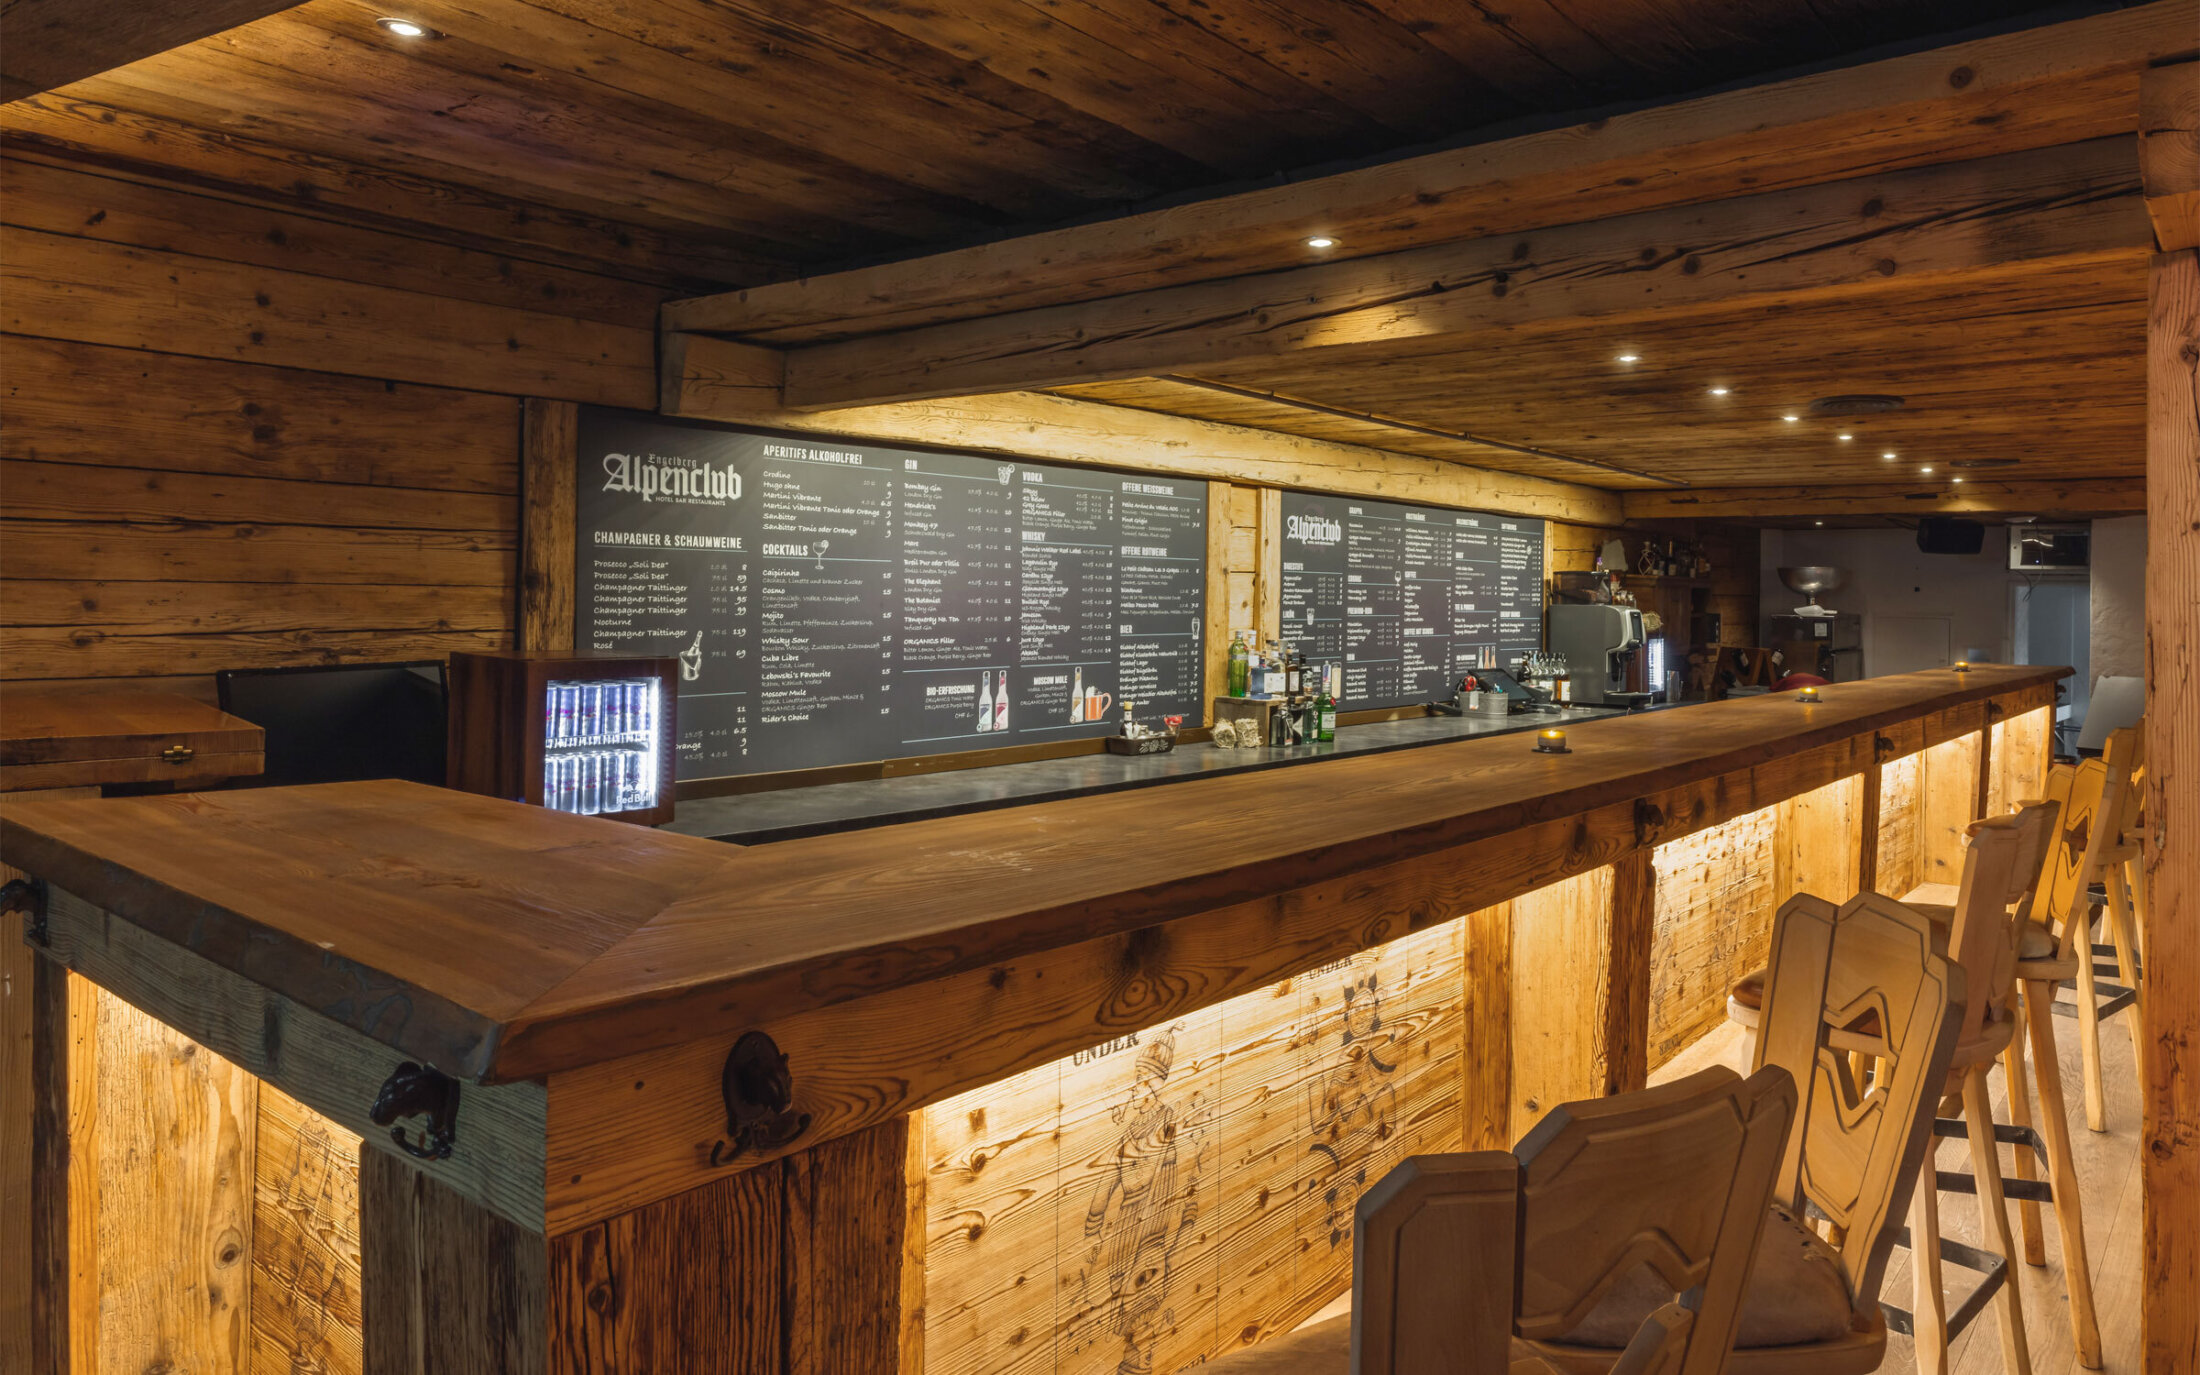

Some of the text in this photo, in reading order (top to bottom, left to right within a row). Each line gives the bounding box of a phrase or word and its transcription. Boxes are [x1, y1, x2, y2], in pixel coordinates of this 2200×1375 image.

[763, 445, 863, 465] APERITIFS ALKOHOLFREI
[905, 459, 918, 470] GIN
[603, 453, 742, 502] Alpenclub
[763, 471, 791, 479] Crodino
[1023, 472, 1043, 482] VODKA
[763, 482, 783, 491] Hugo
[904, 483, 1012, 500] Bombay Gin 9
[1122, 482, 1174, 495] OFFENE WEISSWEINE
[763, 492, 791, 500] Martini
[688, 498, 726, 506] RESTAURANTS
[904, 502, 936, 510] Hendrick's
[763, 502, 791, 510] Martini
[823, 506, 841, 514] Tonic
[856, 509, 880, 518] Orange
[763, 513, 797, 521] Sanbitter
[762, 523, 796, 531] Sanbitter
[798, 525, 817, 533] Tonic
[833, 528, 857, 536] Orange
[904, 522, 929, 531] Monkey
[1287, 515, 1341, 545] Alpenclub
[595, 531, 742, 549] CHAMPAGNER & SCHAUMWEINE
[1022, 531, 1046, 541] WHISKY
[763, 544, 809, 556] COCKTAILS
[1121, 546, 1167, 557] OFFENE ROTWEINE
[594, 560, 627, 568] Prosecco
[594, 572, 627, 580] Prosecco
[737, 575, 747, 583] 59
[762, 568, 800, 578] Caipirinha
[594, 584, 646, 593] Champagner
[648, 584, 688, 593] Taittinger
[594, 595, 646, 604] Champagner
[648, 595, 688, 604] Taittinger
[594, 607, 646, 616] Champagner
[648, 606, 688, 616] Taittinger
[762, 611, 784, 621] Mojito
[904, 617, 937, 625] Tanqueray
[594, 628, 747, 639] Champagner Taittinger 119
[1120, 625, 1133, 634] BIER
[594, 641, 613, 650] Rosé
[762, 637, 790, 647] Whisky
[904, 638, 939, 646] ORGANICS
[761, 671, 799, 680] Lebowski's
[800, 670, 831, 678] Favourite
[1034, 675, 1068, 685] MOSCOW MULE
[761, 715, 787, 723] Rider's
[788, 713, 809, 721] Choice
[740, 738, 747, 747] 9
[616, 794, 634, 805] Red
[1309, 956, 1353, 980] UNDER
[1073, 1032, 1140, 1067] UNDER
